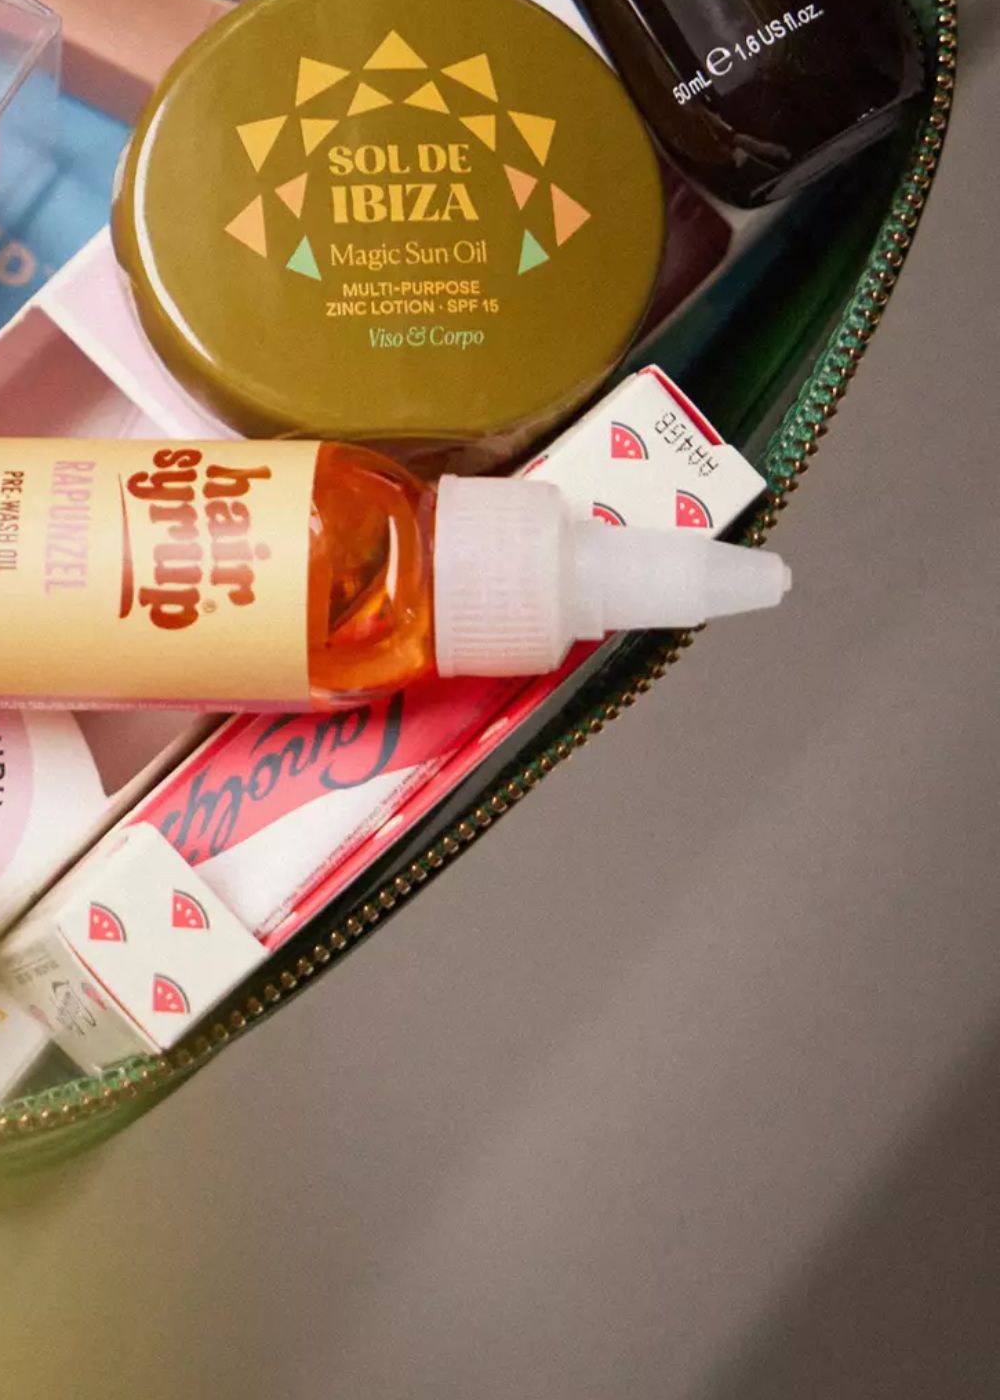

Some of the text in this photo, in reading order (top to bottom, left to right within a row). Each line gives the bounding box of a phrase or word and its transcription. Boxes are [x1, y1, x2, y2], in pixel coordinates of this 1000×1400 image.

[671, 70, 713, 105] 50mL
[733, 33, 761, 62] 1.6
[758, 19, 787, 46] US
[781, 4, 825, 35] fl.oz.
[327, 142, 473, 177] SOL DE
[330, 182, 480, 225] IBIZA
[329, 239, 488, 271] Magic Sun Oil
[325, 298, 500, 317] ZINC LOTION SPF 15
[341, 280, 481, 298] MULTI-PURPOSE
[368, 325, 486, 351] Viso & Corpo
[44, 457, 97, 596] RAPUNZEL
[126, 447, 204, 632] syrup
[203, 463, 273, 608] hair
[160, 688, 408, 867] Lanolip
